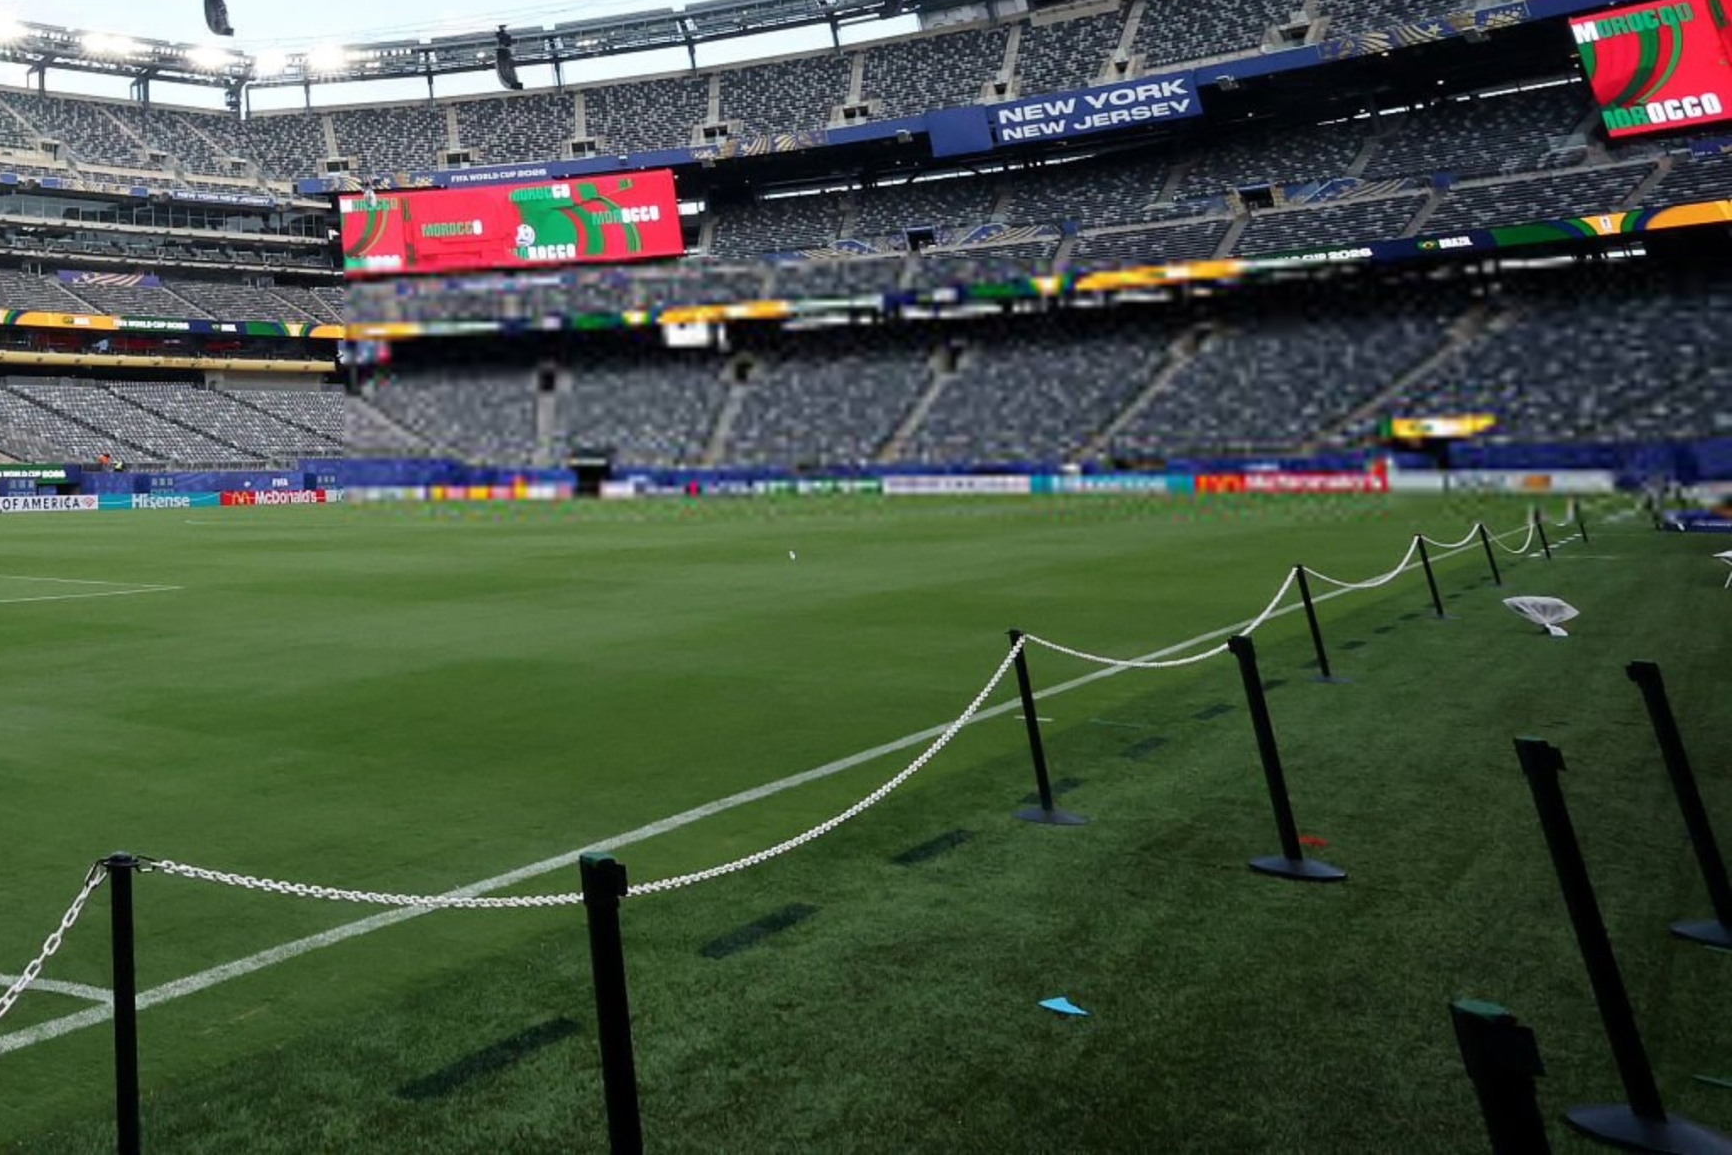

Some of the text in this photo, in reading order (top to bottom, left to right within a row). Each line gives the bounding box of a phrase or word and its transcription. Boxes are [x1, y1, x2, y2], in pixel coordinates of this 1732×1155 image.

[1571, 2, 1695, 45] MOROCCO
[998, 78, 1189, 124] NEW YORK
[1002, 98, 1190, 141] NEW JERSEY
[451, 173, 469, 183] FIFA
[469, 171, 499, 181] WORLD
[499, 169, 516, 179] CUP
[592, 206, 661, 225] MOROCCO
[421, 219, 483, 237] MOROCCO
[1438, 236, 1473, 249] BRAZIL
[2, 498, 18, 510] OF
[21, 496, 81, 510] AMERICA
[132, 494, 190, 508] Hisense
[255, 490, 318, 505] McDonald's
